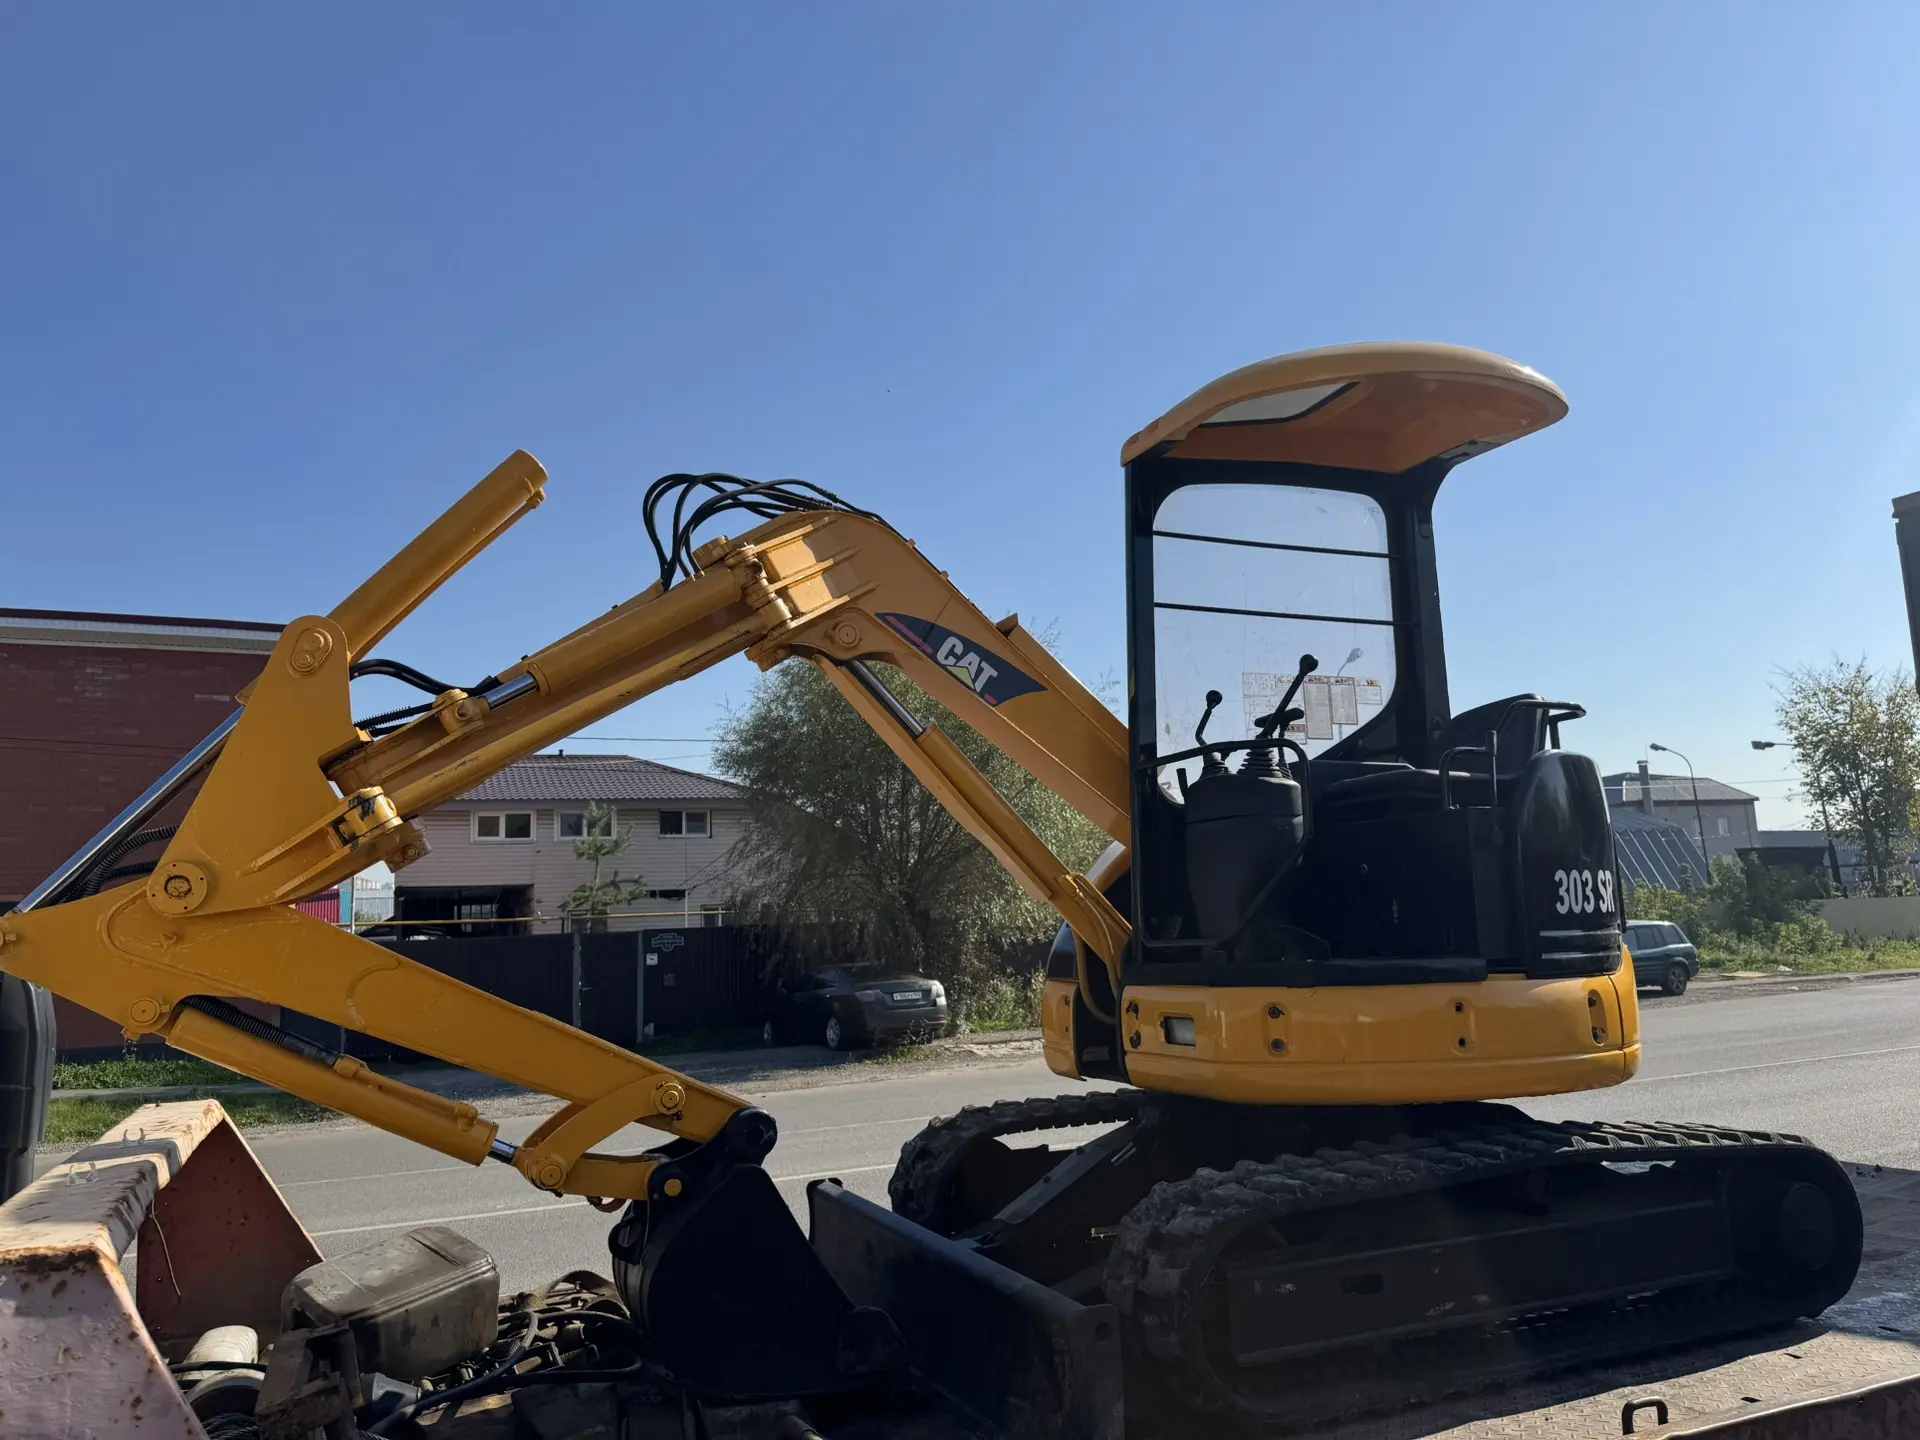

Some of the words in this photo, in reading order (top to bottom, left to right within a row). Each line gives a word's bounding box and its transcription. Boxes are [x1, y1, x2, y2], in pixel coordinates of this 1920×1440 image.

[936, 636, 998, 692] CAT
[1554, 869, 1595, 914] 303
[1597, 869, 1615, 913] SR
